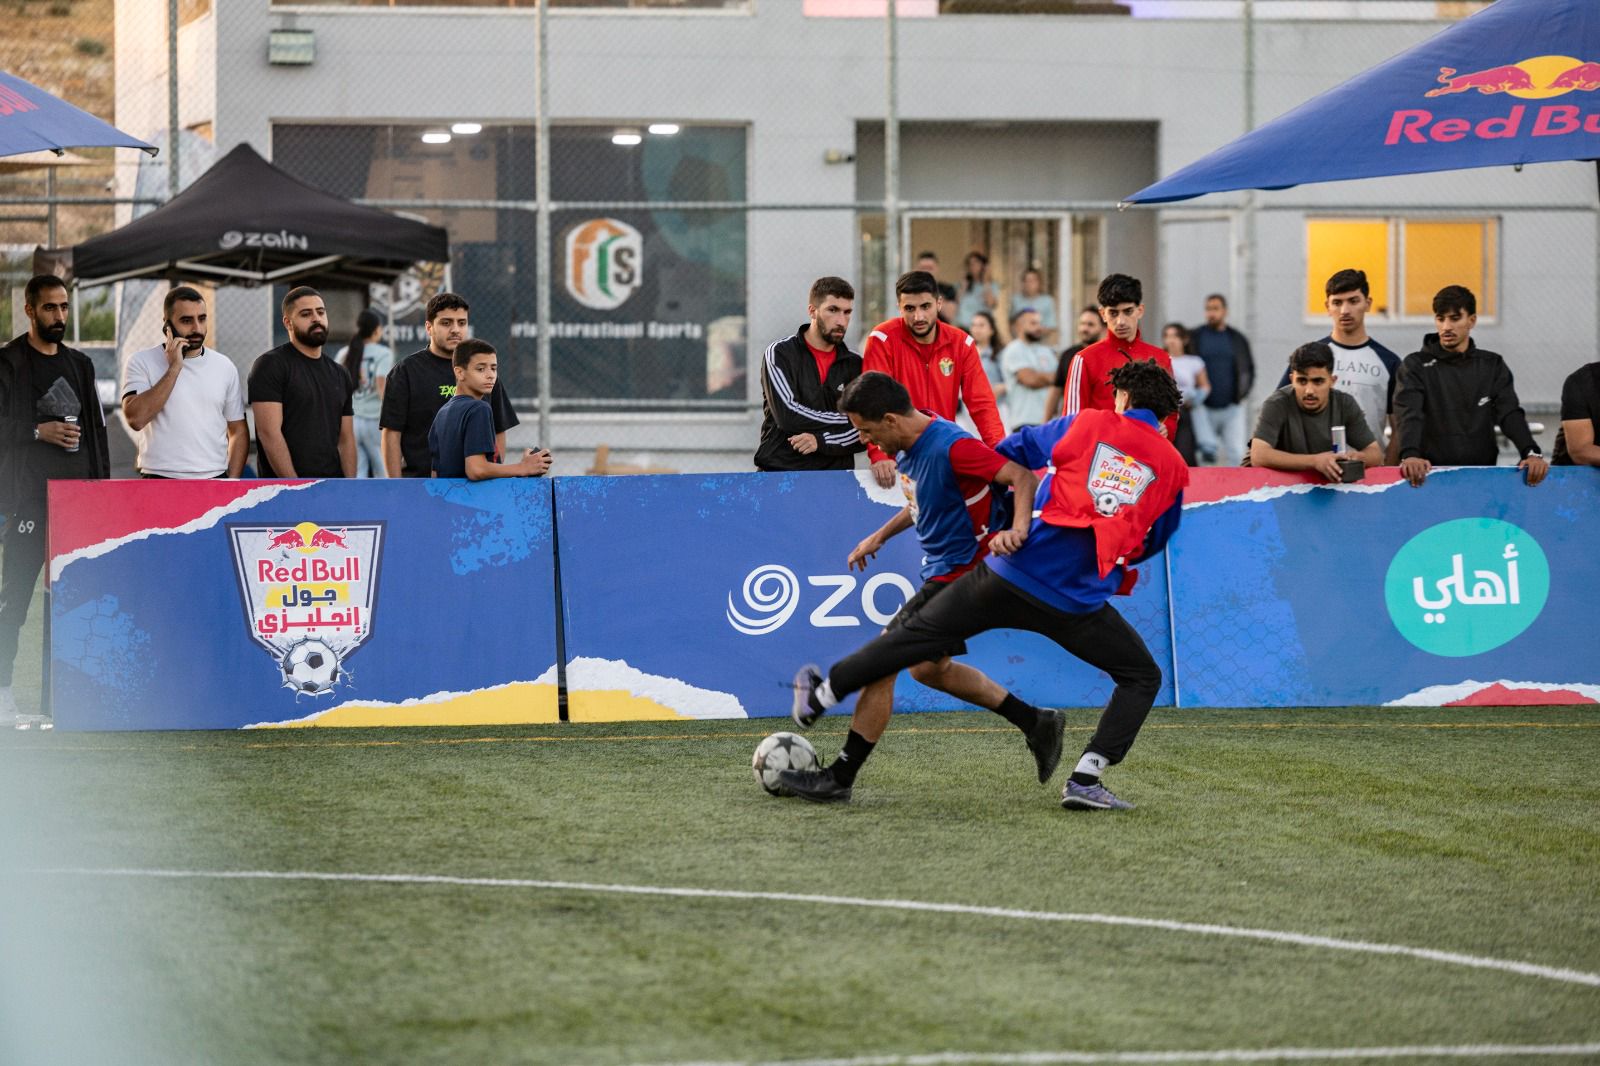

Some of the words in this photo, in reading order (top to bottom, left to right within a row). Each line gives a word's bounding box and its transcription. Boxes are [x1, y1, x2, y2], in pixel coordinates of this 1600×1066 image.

[1384, 104, 1526, 145] Red
[1336, 359, 1381, 377] LANO
[1100, 460, 1123, 474] Red
[1123, 469, 1145, 486] Bull
[18, 519, 35, 534] 69
[258, 558, 308, 582] Red
[312, 557, 360, 581] Bull
[282, 584, 337, 607] جول
[1412, 543, 1520, 624] أهلي
[807, 571, 918, 628] za
[257, 606, 361, 639] إنجليزي
